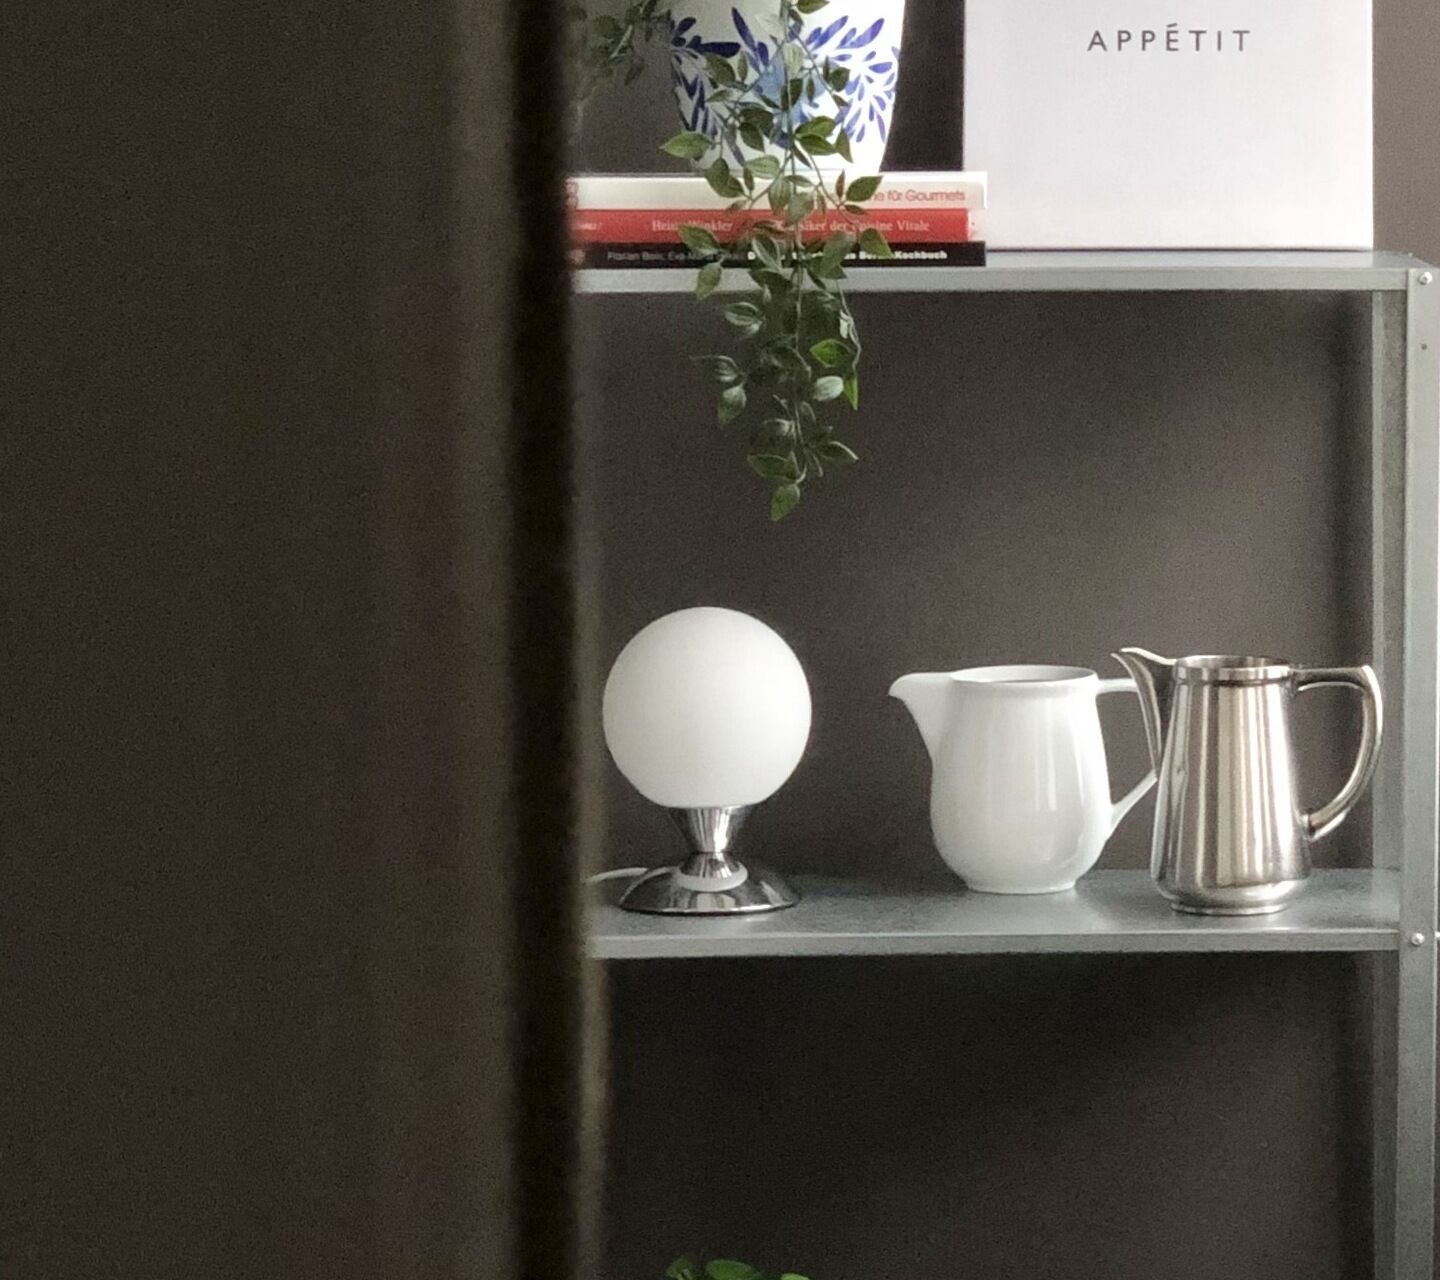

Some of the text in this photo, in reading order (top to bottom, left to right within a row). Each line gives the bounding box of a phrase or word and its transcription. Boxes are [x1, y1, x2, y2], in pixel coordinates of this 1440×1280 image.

[1087, 23, 1251, 52] APPÉTIT
[888, 189, 903, 201] für
[905, 188, 966, 202] Gourmets
[652, 219, 685, 232] Hein
[688, 219, 733, 232] Wnkler
[894, 250, 948, 261] Kochbuch
